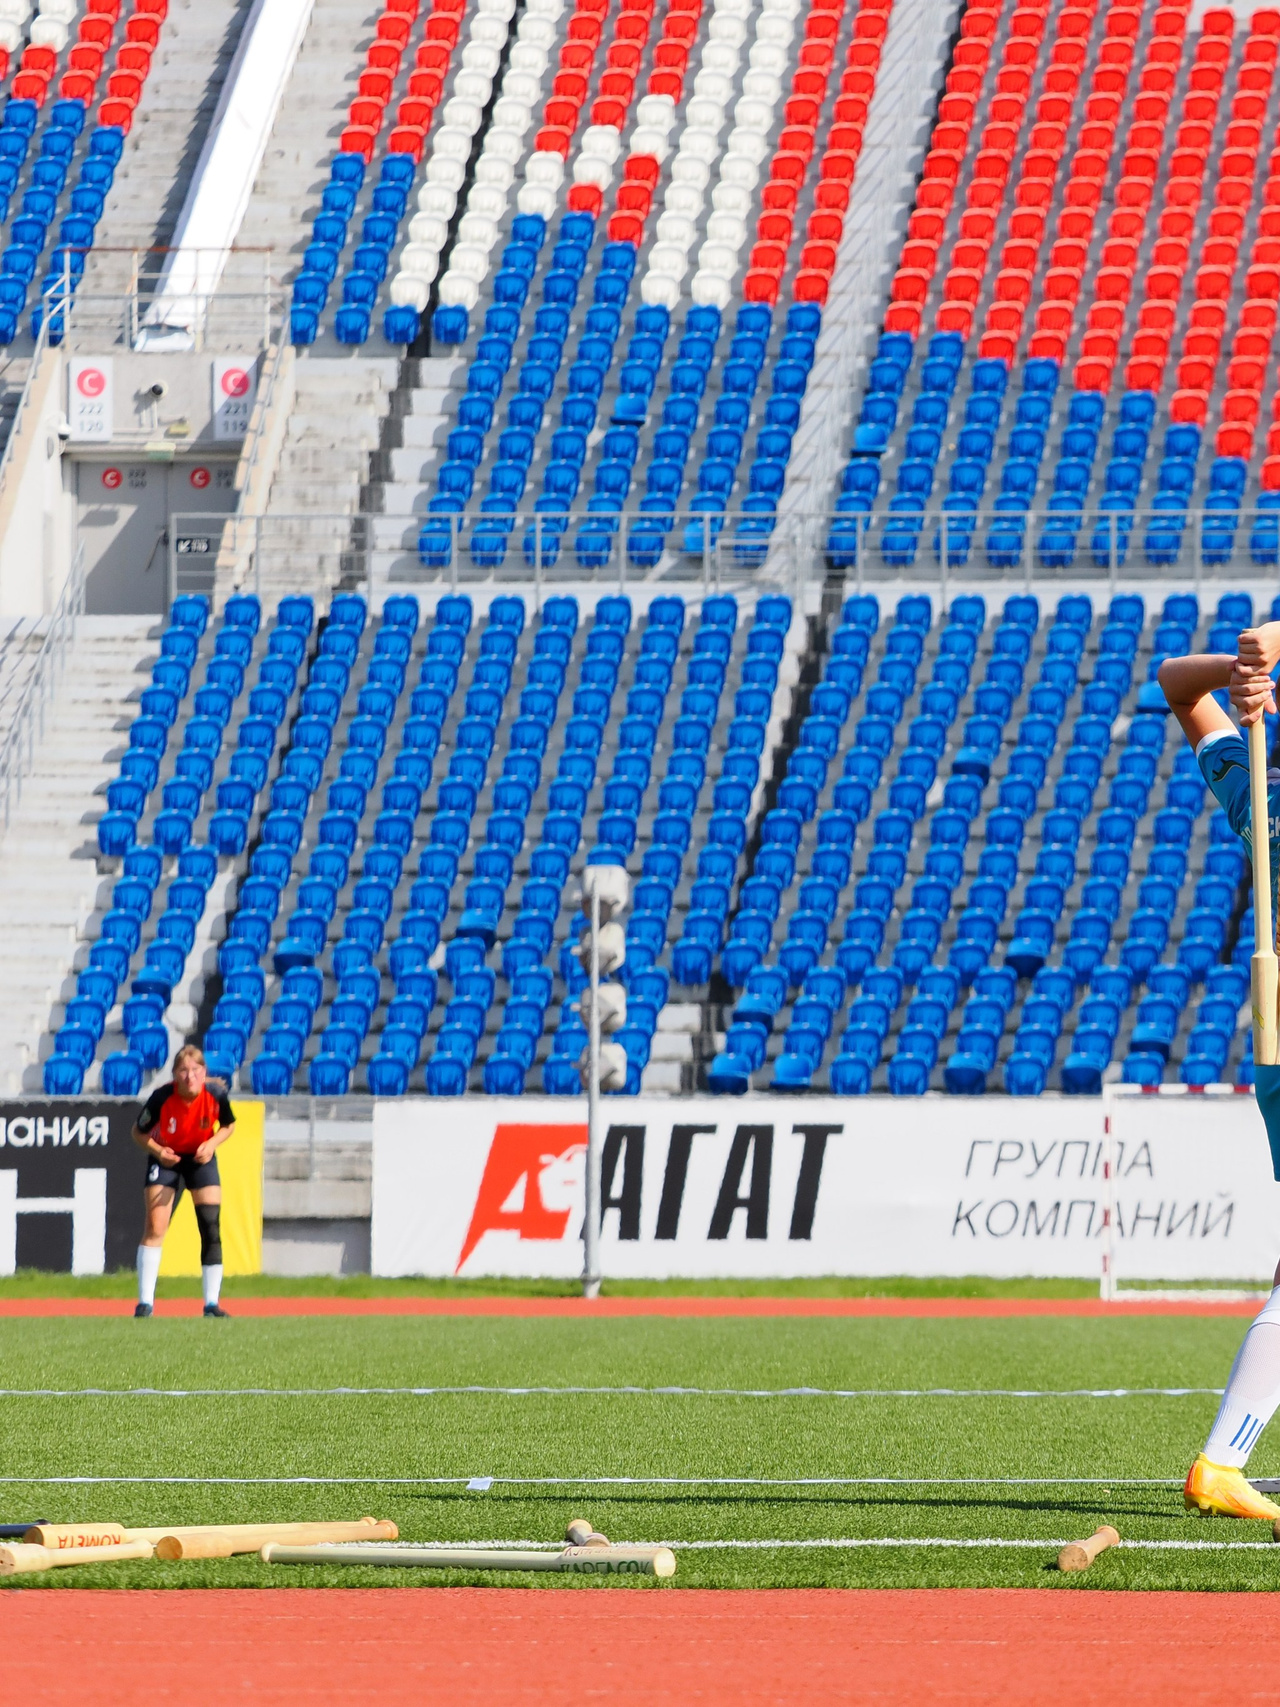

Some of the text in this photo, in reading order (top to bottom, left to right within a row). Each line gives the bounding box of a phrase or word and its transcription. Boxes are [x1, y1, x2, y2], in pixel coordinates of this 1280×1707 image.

[0, 1116, 110, 1147] ания
[965, 1140, 1154, 1178] ГРУППА
[578, 1124, 844, 1241] АГАТ
[952, 1190, 1236, 1239] КОМПАНИЙ
